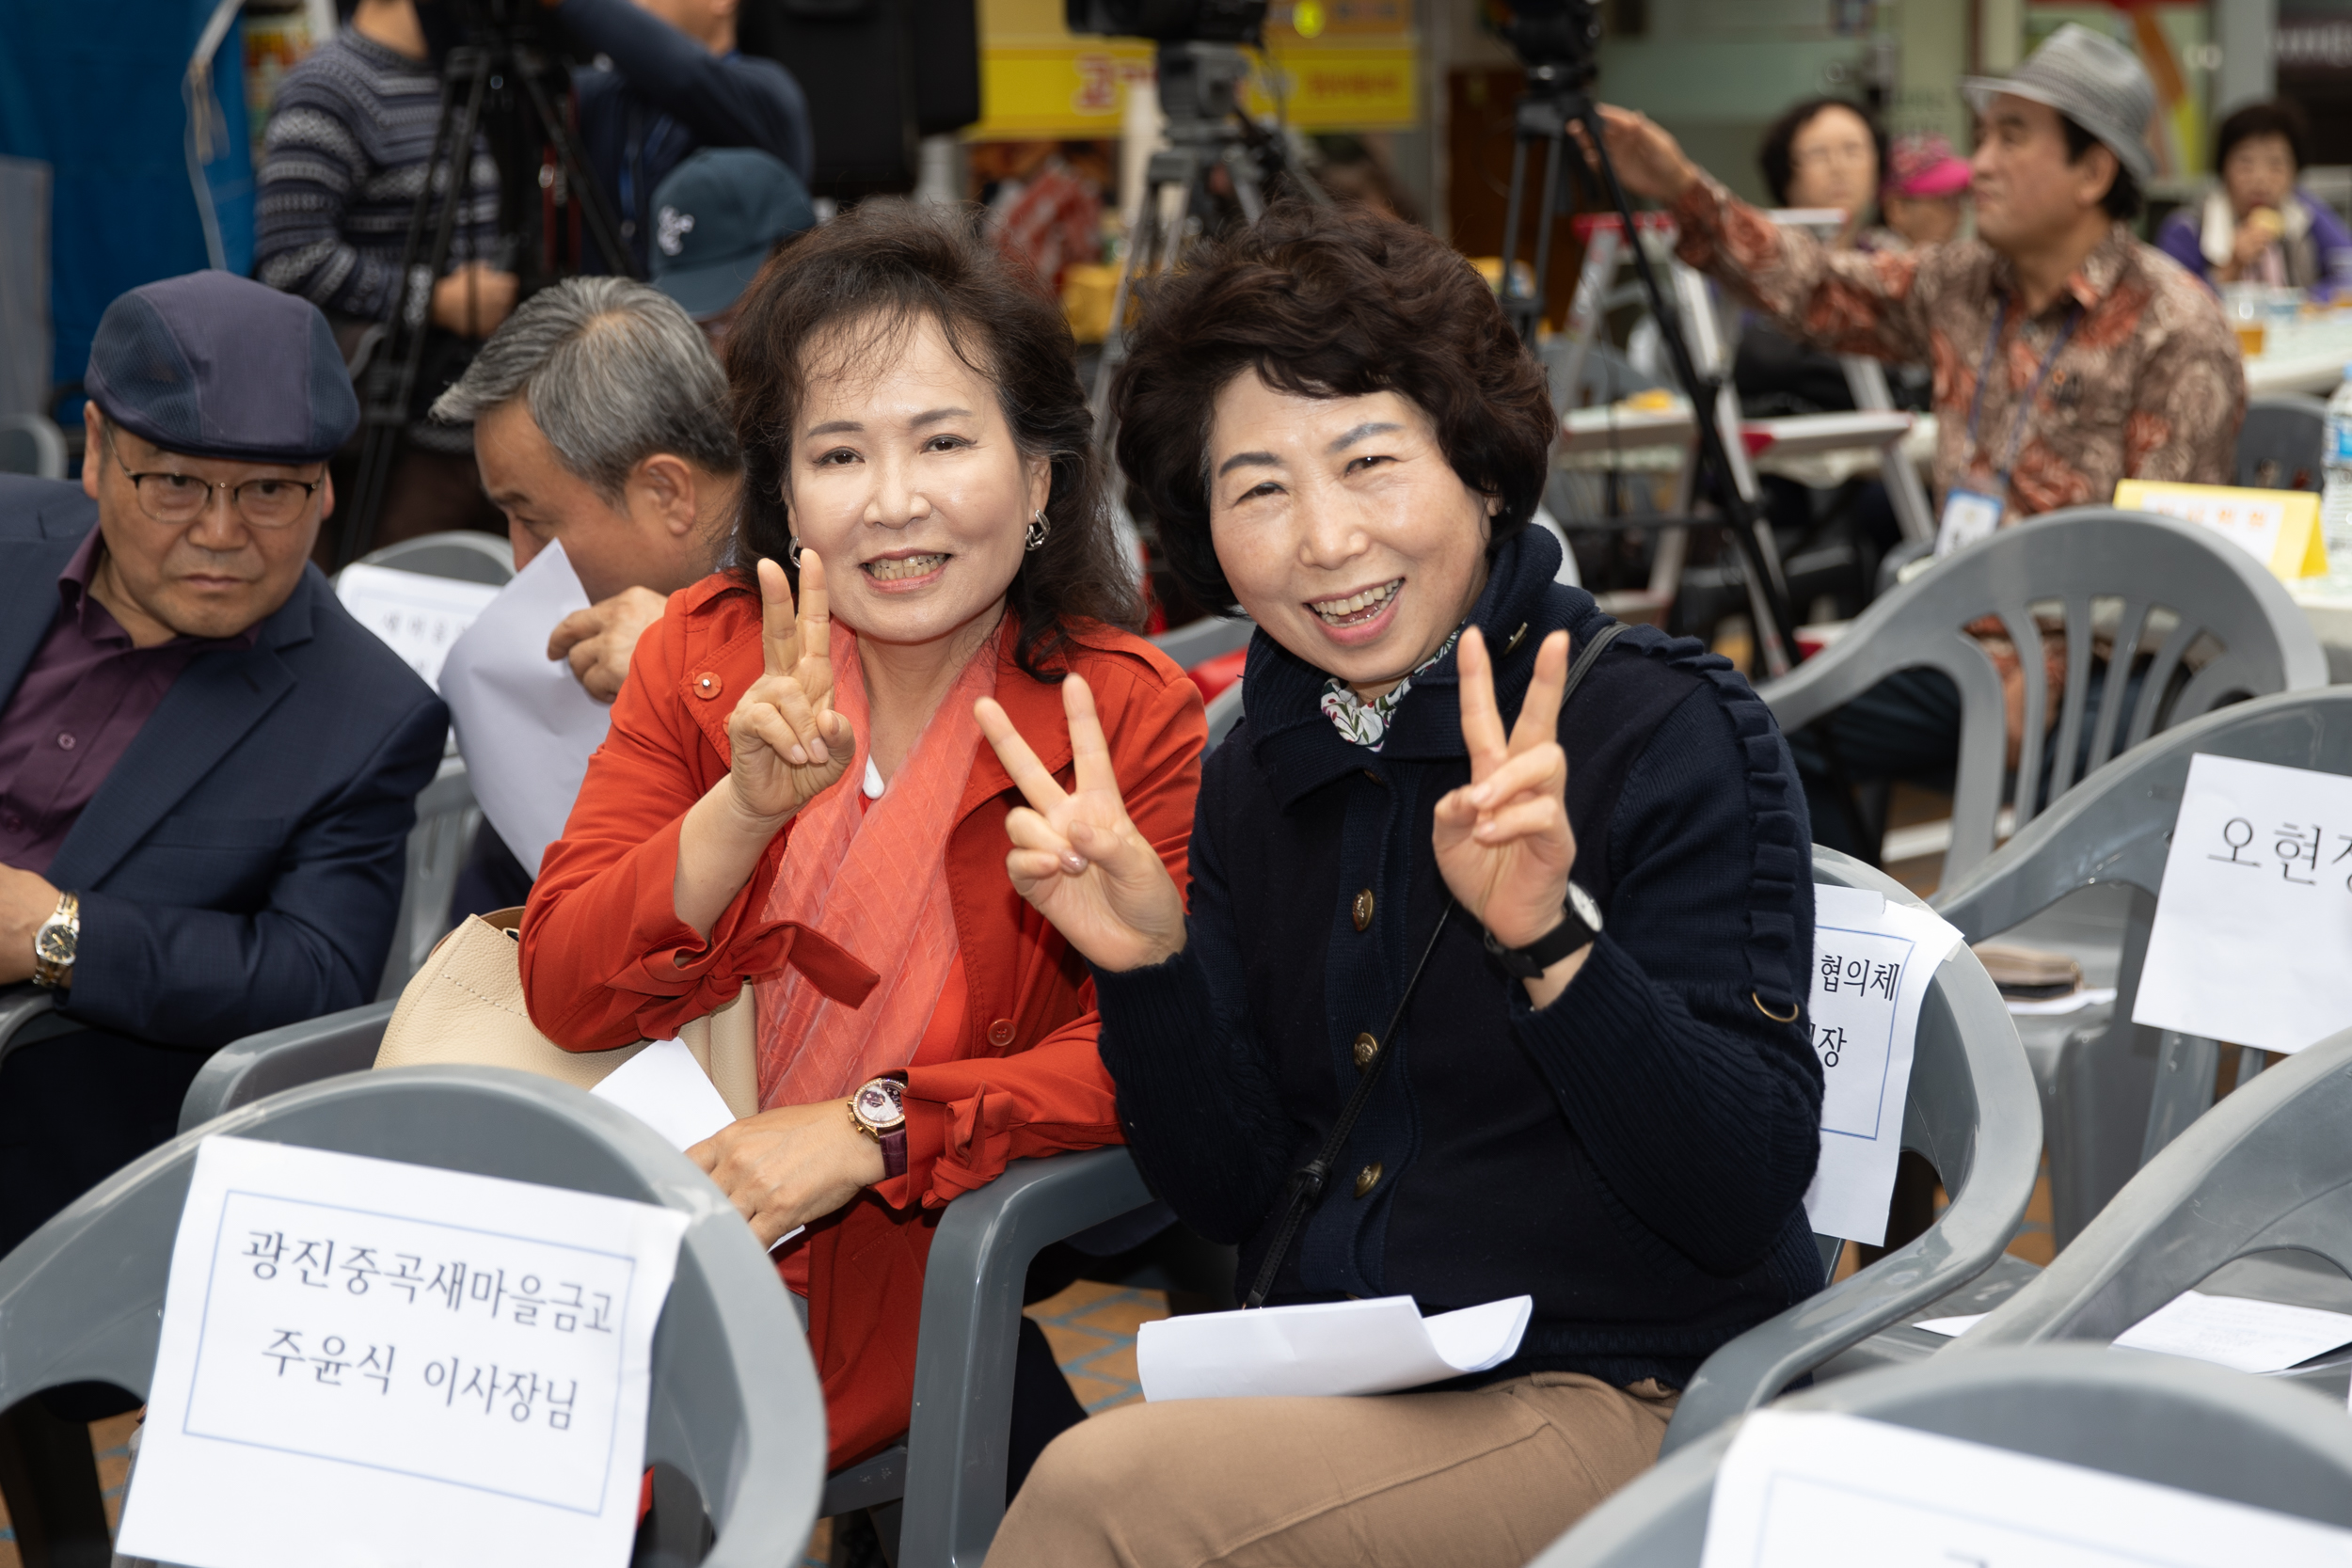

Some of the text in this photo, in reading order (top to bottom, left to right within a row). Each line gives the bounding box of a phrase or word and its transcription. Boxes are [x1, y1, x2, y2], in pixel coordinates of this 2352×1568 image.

[1820, 954, 1900, 1002] 협의체
[1809, 1022, 1848, 1068] 장
[242, 1230, 613, 1334] 광진중곡새마을금고
[262, 1328, 579, 1432] 주윤식 이사장님
